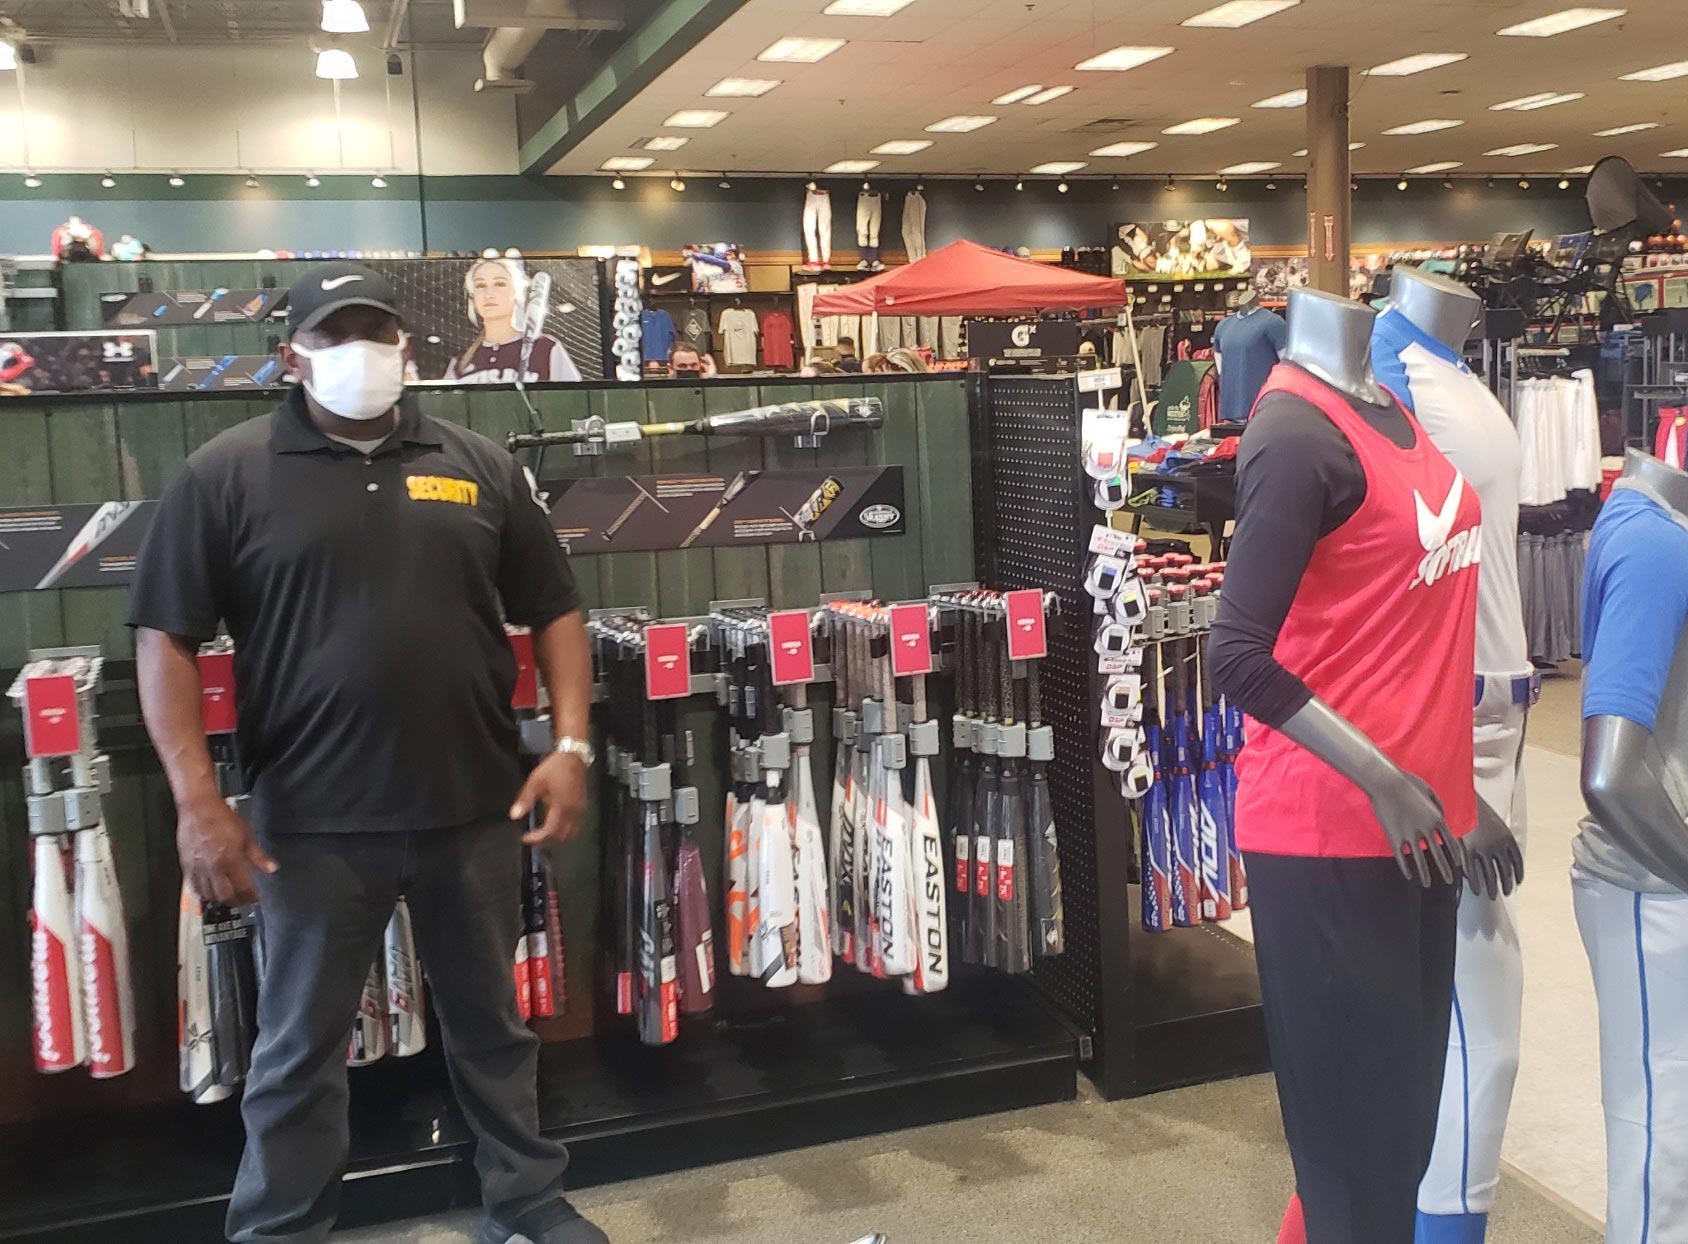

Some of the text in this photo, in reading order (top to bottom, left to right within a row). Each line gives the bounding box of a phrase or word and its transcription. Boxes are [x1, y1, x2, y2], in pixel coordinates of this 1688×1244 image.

[405, 475, 479, 506] SECURITY
[880, 836, 895, 960] EASTON
[923, 834, 943, 975] EASTON
